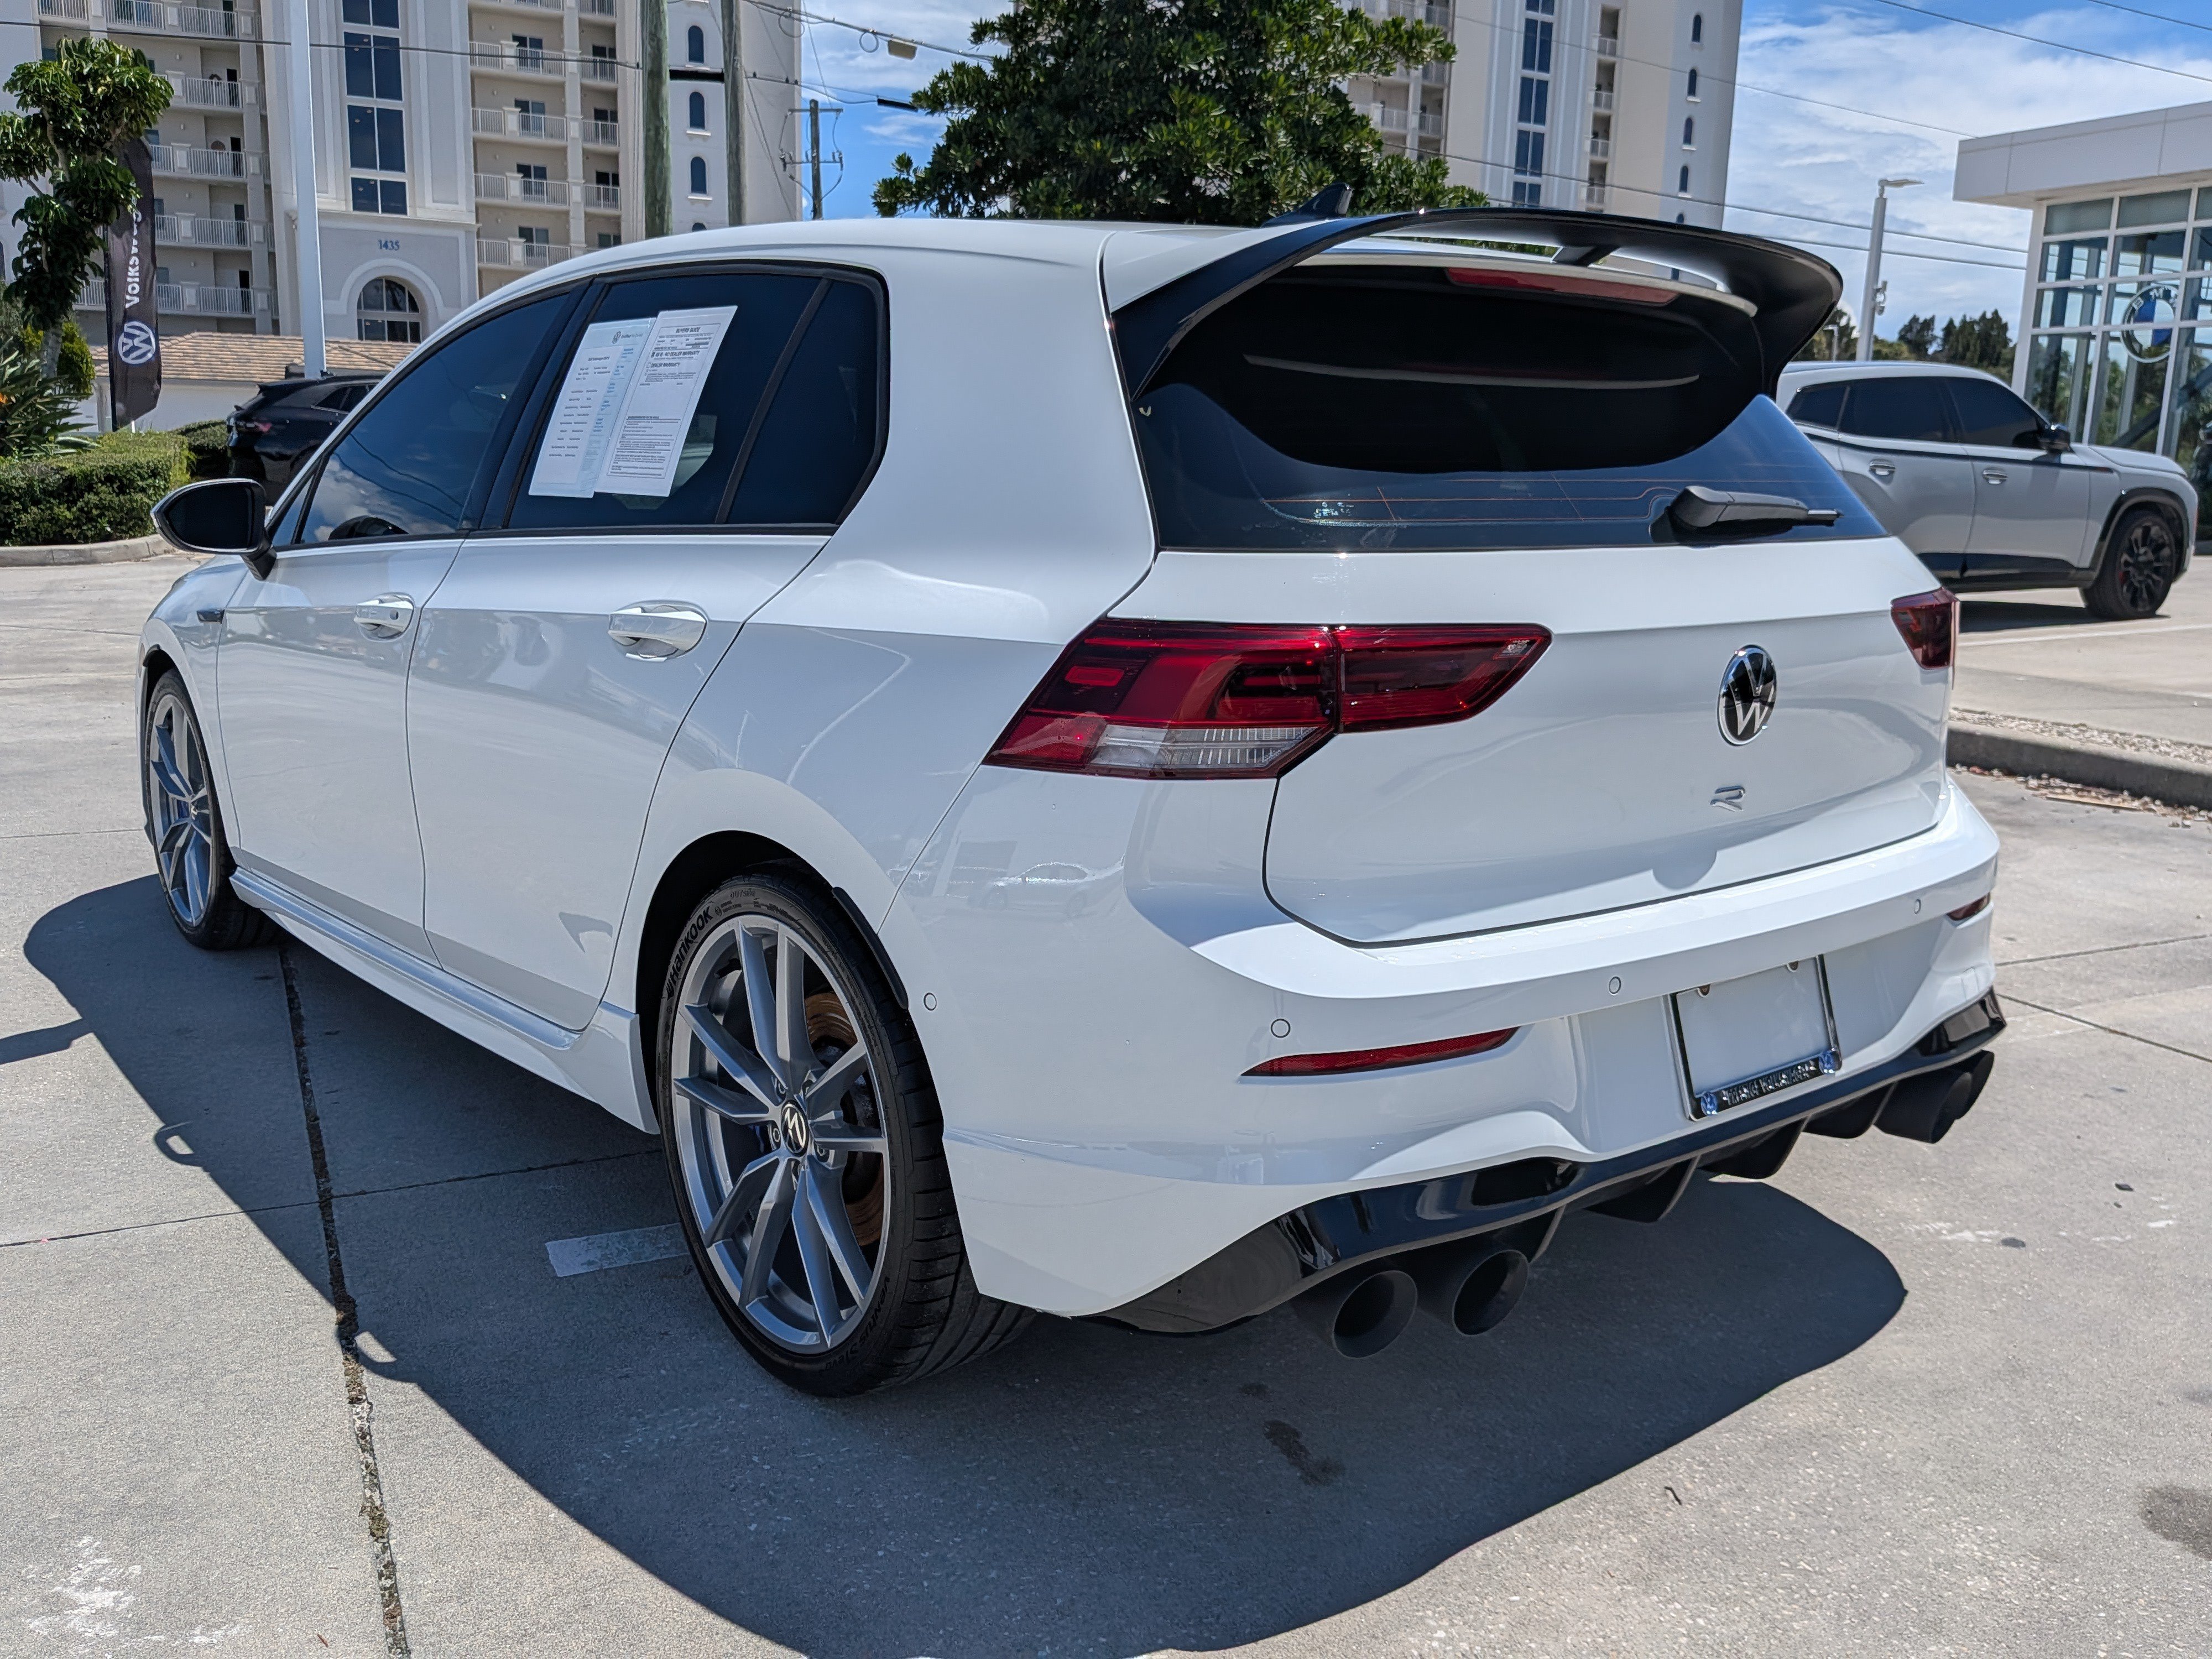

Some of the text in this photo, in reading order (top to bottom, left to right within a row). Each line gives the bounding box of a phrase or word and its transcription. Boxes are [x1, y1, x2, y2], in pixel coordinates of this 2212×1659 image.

[378, 239, 400, 251] 1435
[1710, 785, 1746, 812] R
[669, 904, 713, 983] Hankook
